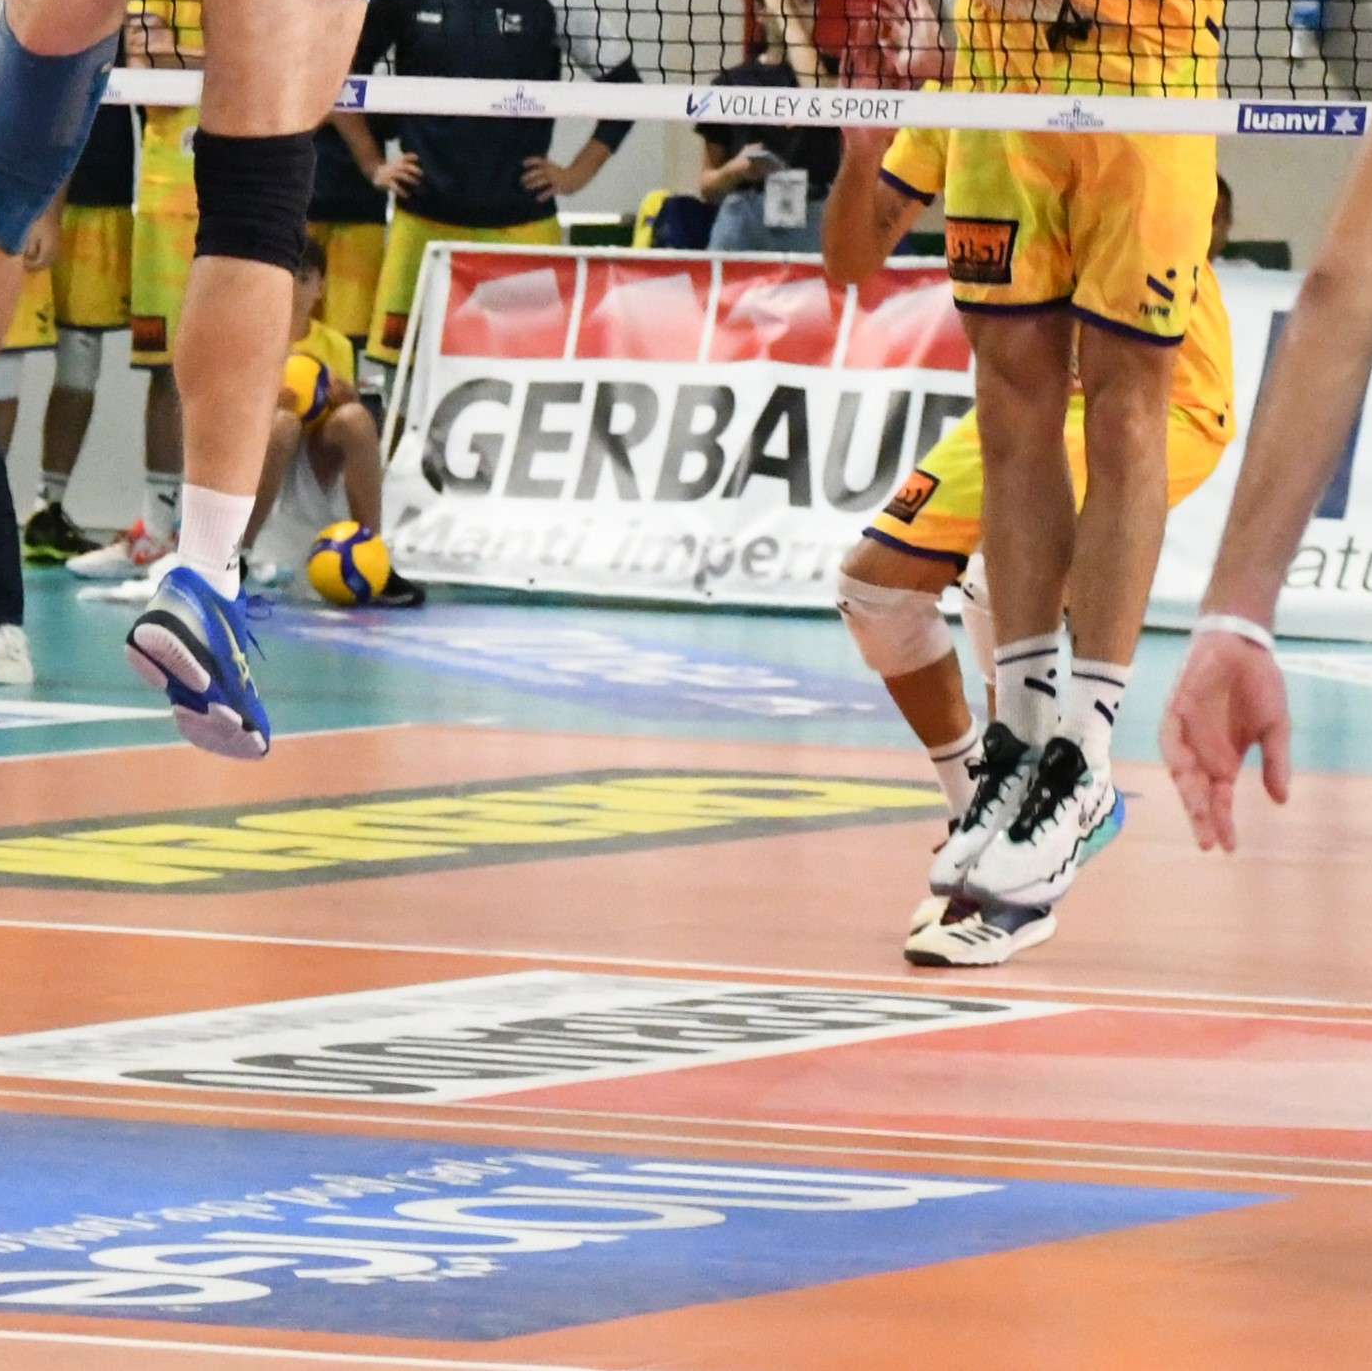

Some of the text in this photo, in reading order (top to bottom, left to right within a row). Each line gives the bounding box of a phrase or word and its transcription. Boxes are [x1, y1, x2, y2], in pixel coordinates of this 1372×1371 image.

[718, 92, 905, 120] VOLLEY & SPORT
[422, 378, 975, 514] GERBAU
[119, 994, 1013, 1096] GERBAUDO
